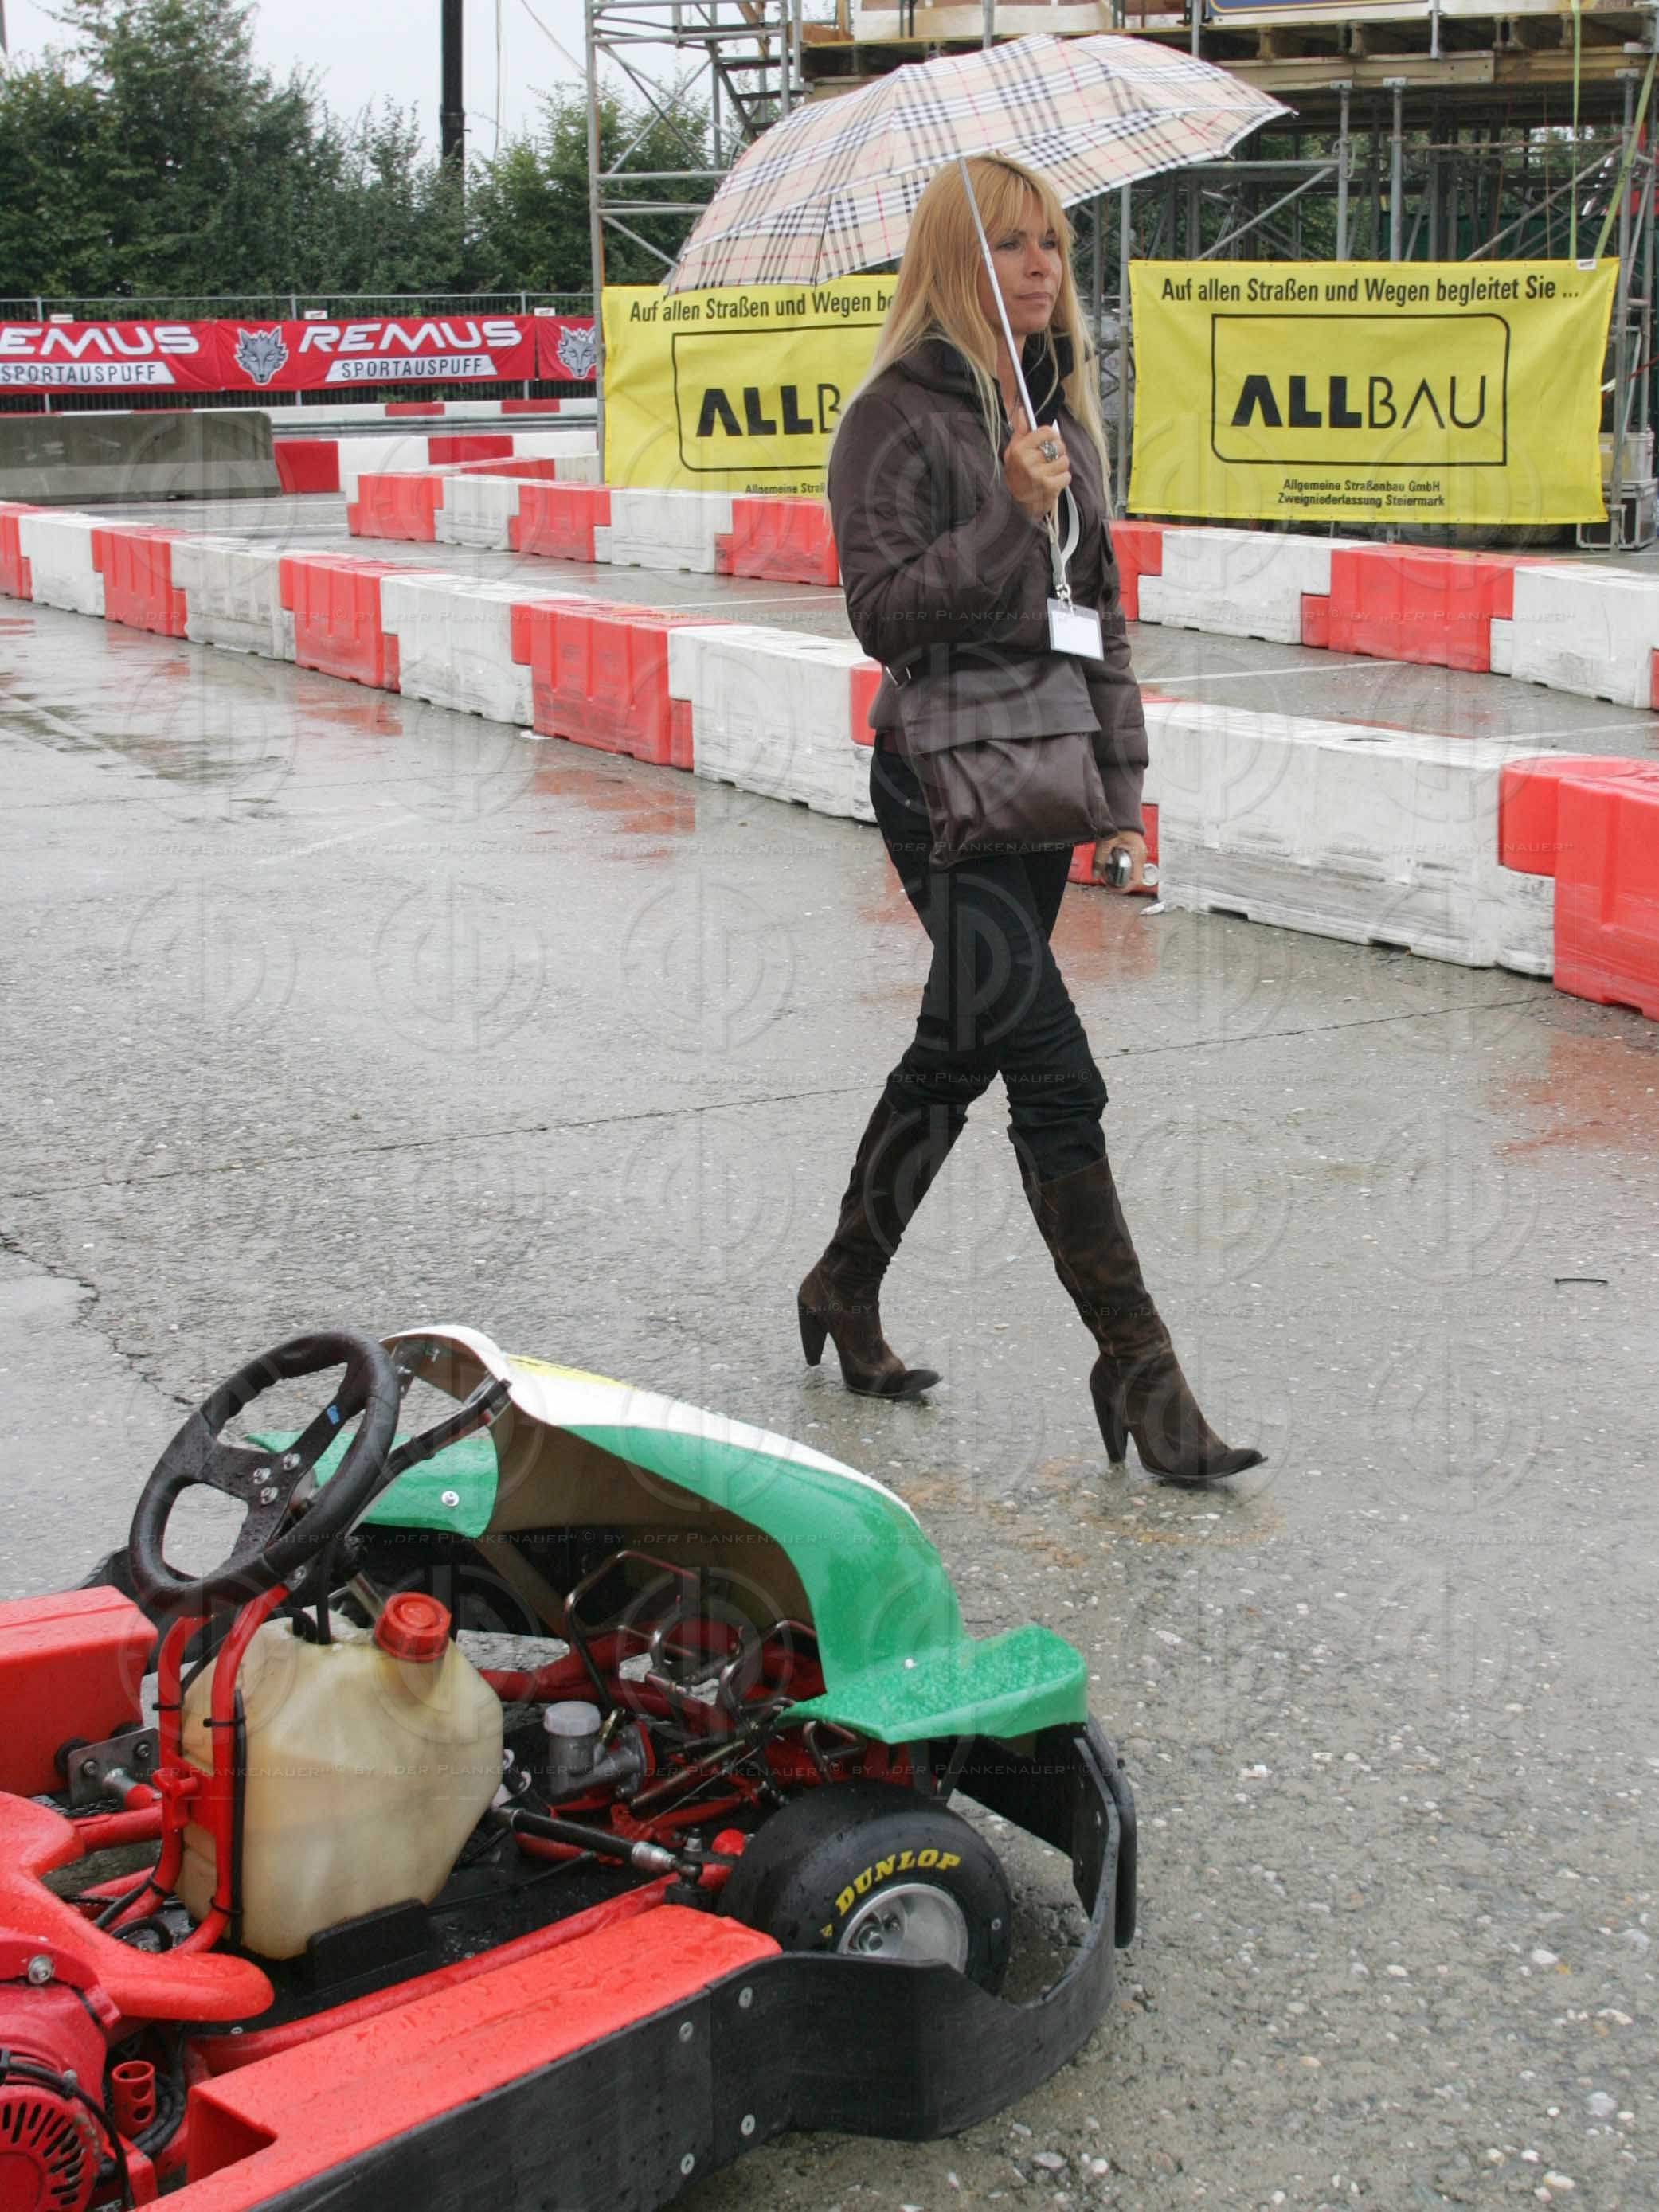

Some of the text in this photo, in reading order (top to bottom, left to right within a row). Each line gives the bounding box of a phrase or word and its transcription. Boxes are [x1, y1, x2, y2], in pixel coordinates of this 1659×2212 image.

[630, 300, 659, 322] Auf
[663, 300, 700, 320] allen
[706, 297, 769, 319] Straßen
[776, 292, 806, 316] und
[812, 291, 871, 318] Wegen
[1162, 279, 1192, 301] Auf
[1198, 279, 1240, 301] allen
[1247, 279, 1318, 302] Straßen
[1325, 279, 1358, 302] und
[1365, 278, 1429, 307] Wegen
[1436, 276, 1519, 307] begleitet
[1525, 275, 1555, 299] Sie
[299, 320, 522, 354] REMUS
[2, 364, 157, 383] SPORTAUSPUFF
[342, 358, 482, 378] SPORTAUSPUFF
[1231, 374, 1486, 428] ALLBAU
[1283, 479, 1441, 493] Allgemeine Straßenbau GmbH
[1386, 494, 1446, 507] Steiermark
[835, 1849, 961, 1917] DUNLOP
